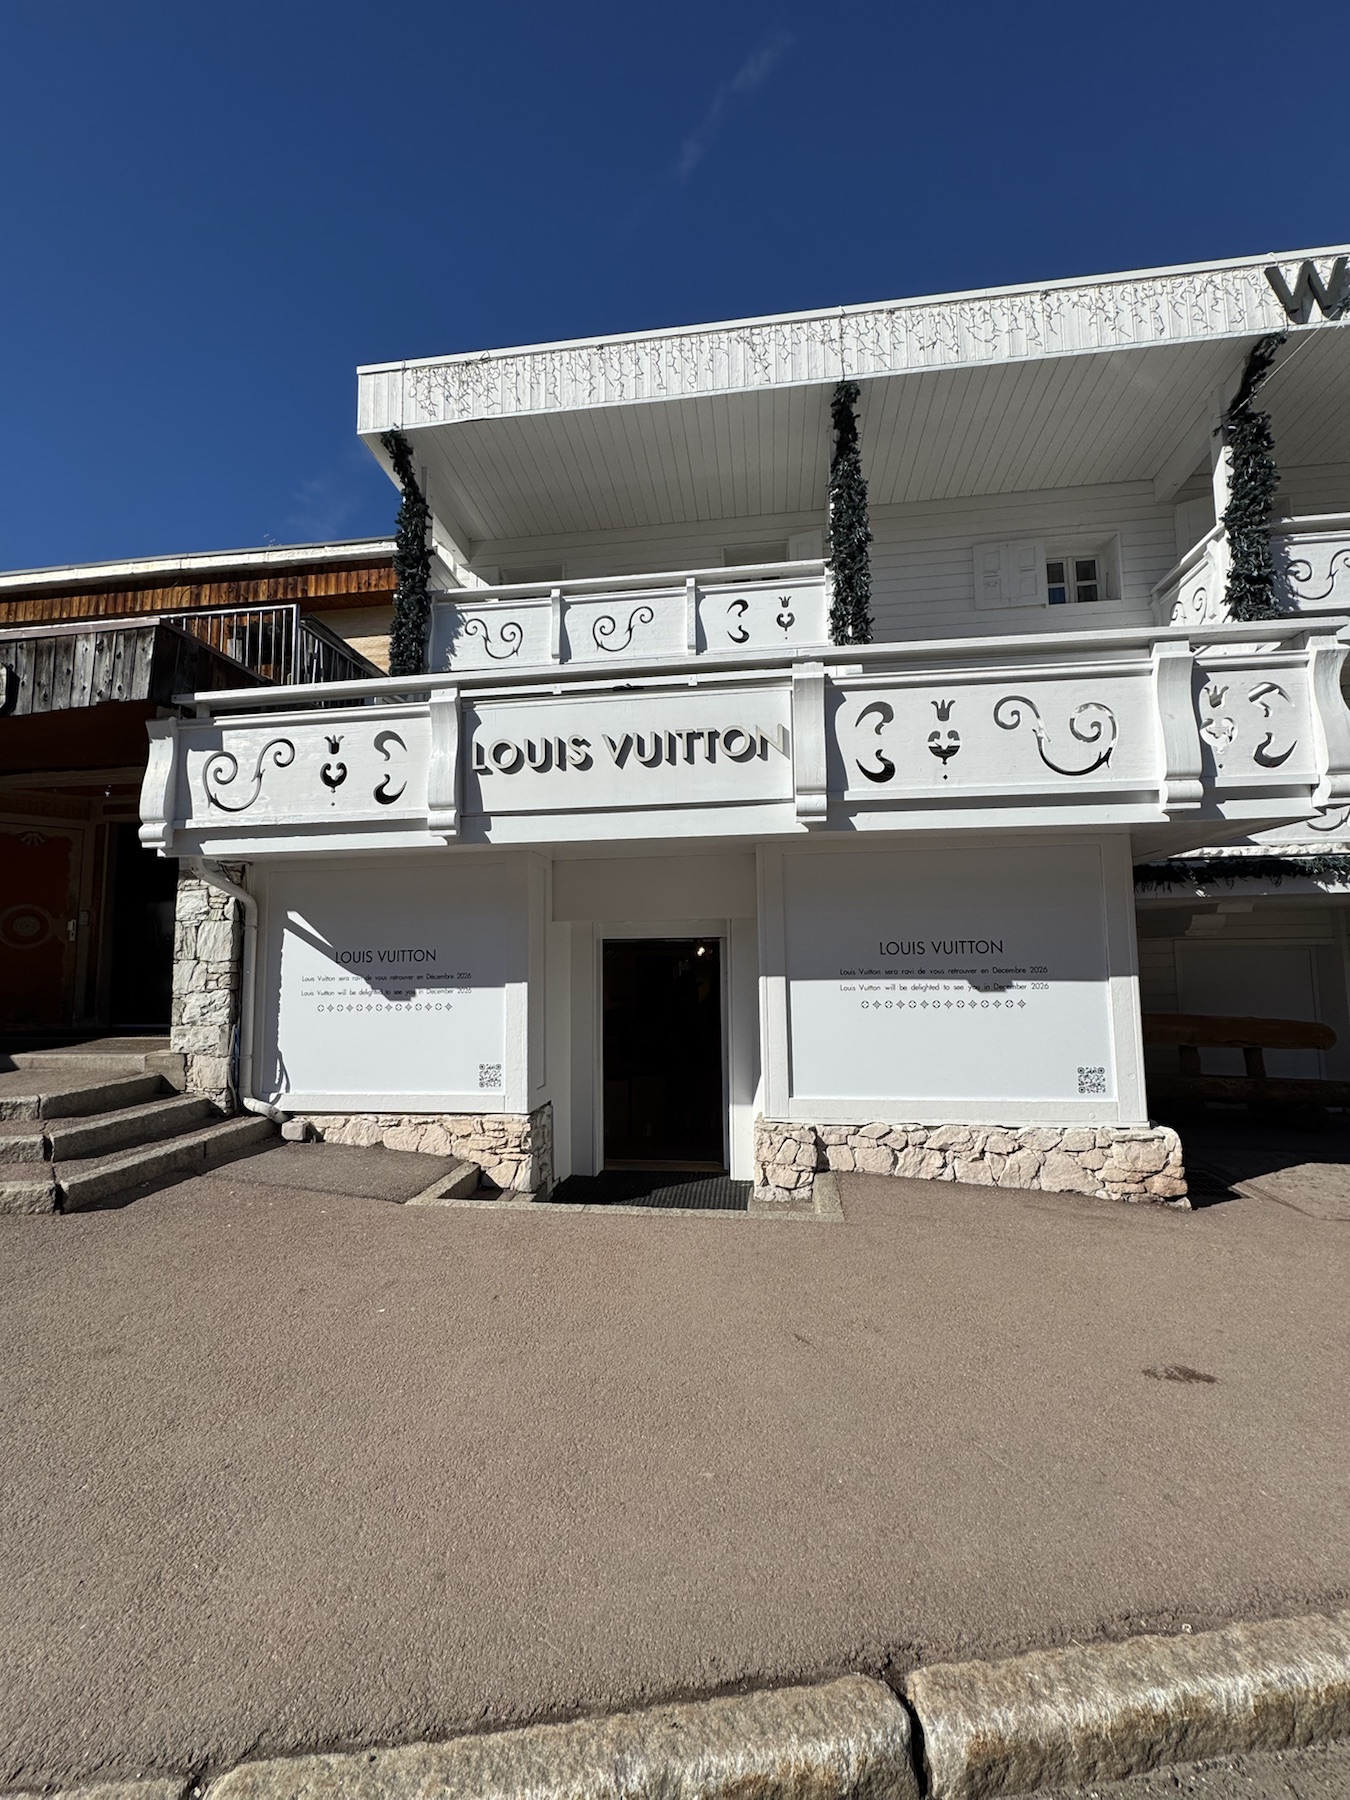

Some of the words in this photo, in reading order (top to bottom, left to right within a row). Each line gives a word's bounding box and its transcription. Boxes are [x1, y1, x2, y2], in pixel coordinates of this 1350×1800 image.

[472, 734, 590, 772] LOUIS
[602, 723, 788, 767] VUITTON
[879, 941, 925, 955] LOUIS
[931, 940, 1003, 954] VUITTON
[335, 951, 373, 964] LOUIS
[378, 949, 436, 963] VUITTON
[918, 967, 926, 975] de
[948, 967, 977, 975] retrouver
[1030, 965, 1048, 974] 2026
[338, 988, 348, 996] will
[350, 988, 357, 996] be
[405, 989, 416, 997] you
[911, 983, 940, 993] delighted
[967, 983, 981, 992] you
[984, 982, 991, 990] in
[993, 982, 1027, 990] December
[1031, 982, 1050, 990] 2026
